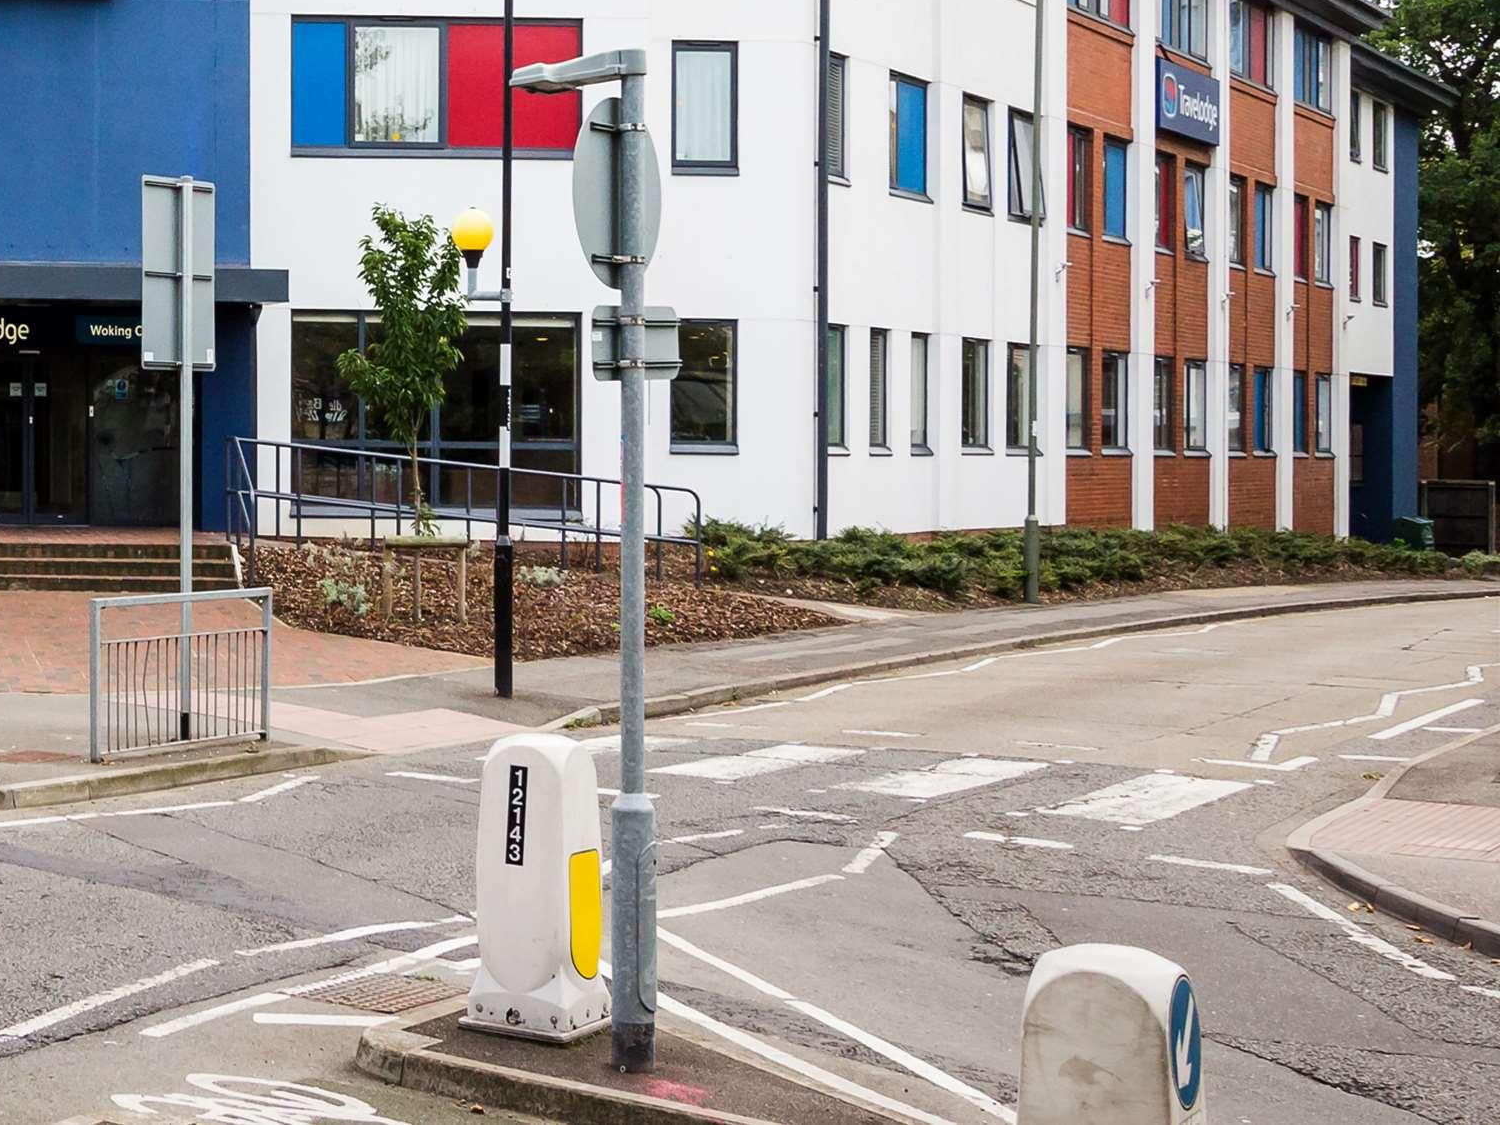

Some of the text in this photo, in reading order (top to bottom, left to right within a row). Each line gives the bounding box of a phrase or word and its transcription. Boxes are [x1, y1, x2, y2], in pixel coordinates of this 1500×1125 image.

[1178, 84, 1218, 131] Travelodge
[90, 324, 132, 339] Woking
[508, 768, 524, 862] 12143
